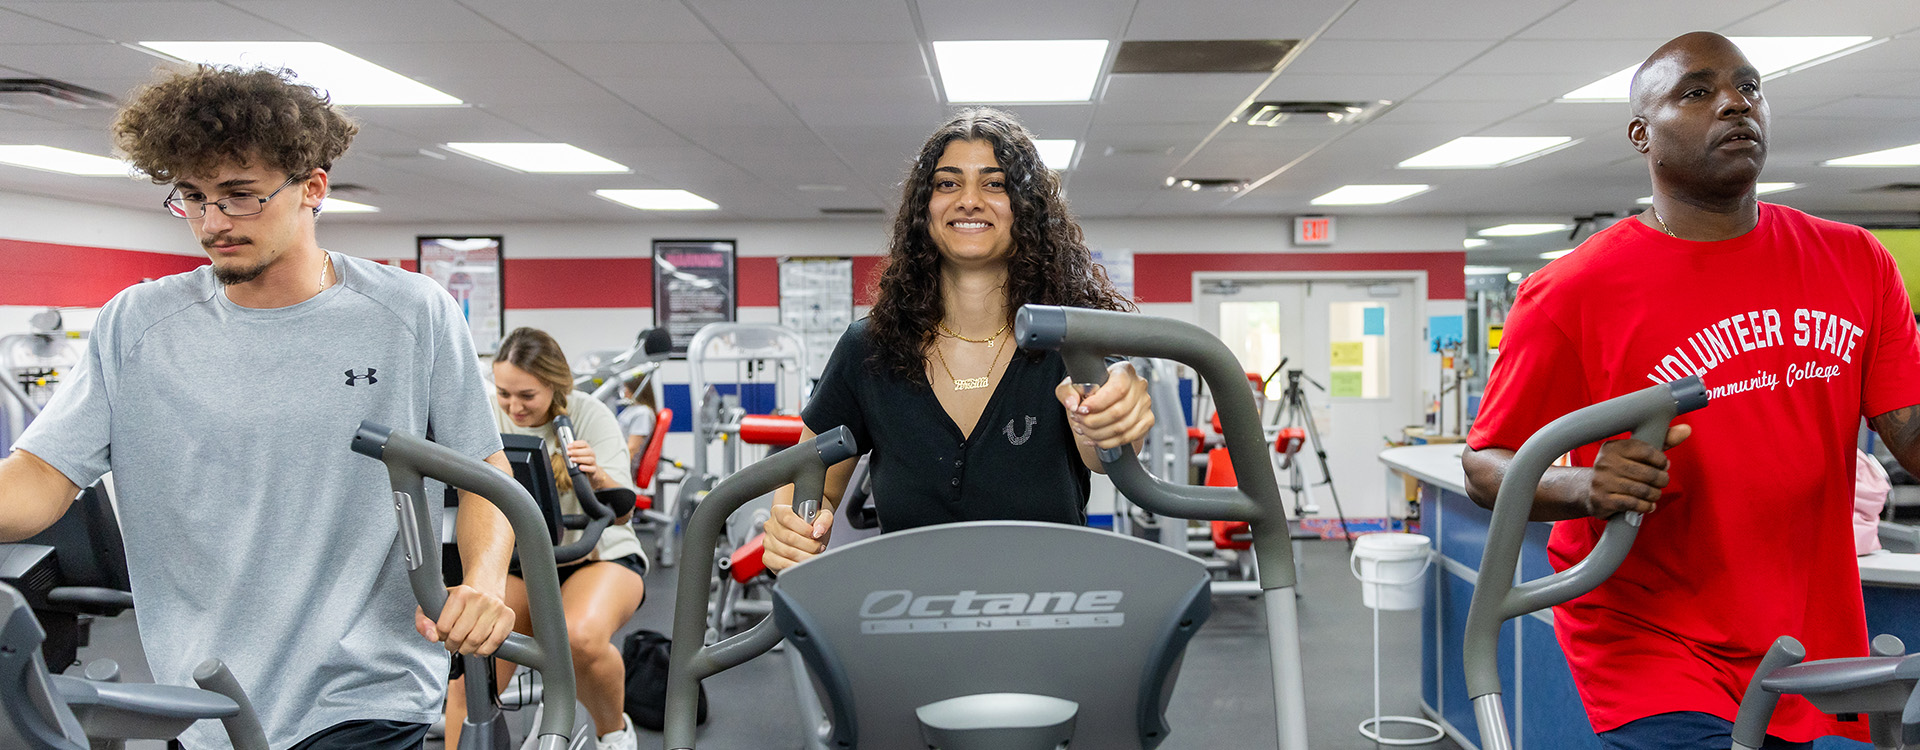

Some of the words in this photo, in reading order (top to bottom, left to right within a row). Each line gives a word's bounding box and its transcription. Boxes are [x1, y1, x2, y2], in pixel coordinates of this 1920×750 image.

[1303, 219, 1329, 241] EXIT
[1793, 308, 1864, 364] STATE
[1706, 370, 1780, 401] ommunity
[1786, 361, 1841, 387] College
[859, 590, 1124, 617] Octane
[870, 617, 1110, 631] FITNESS
